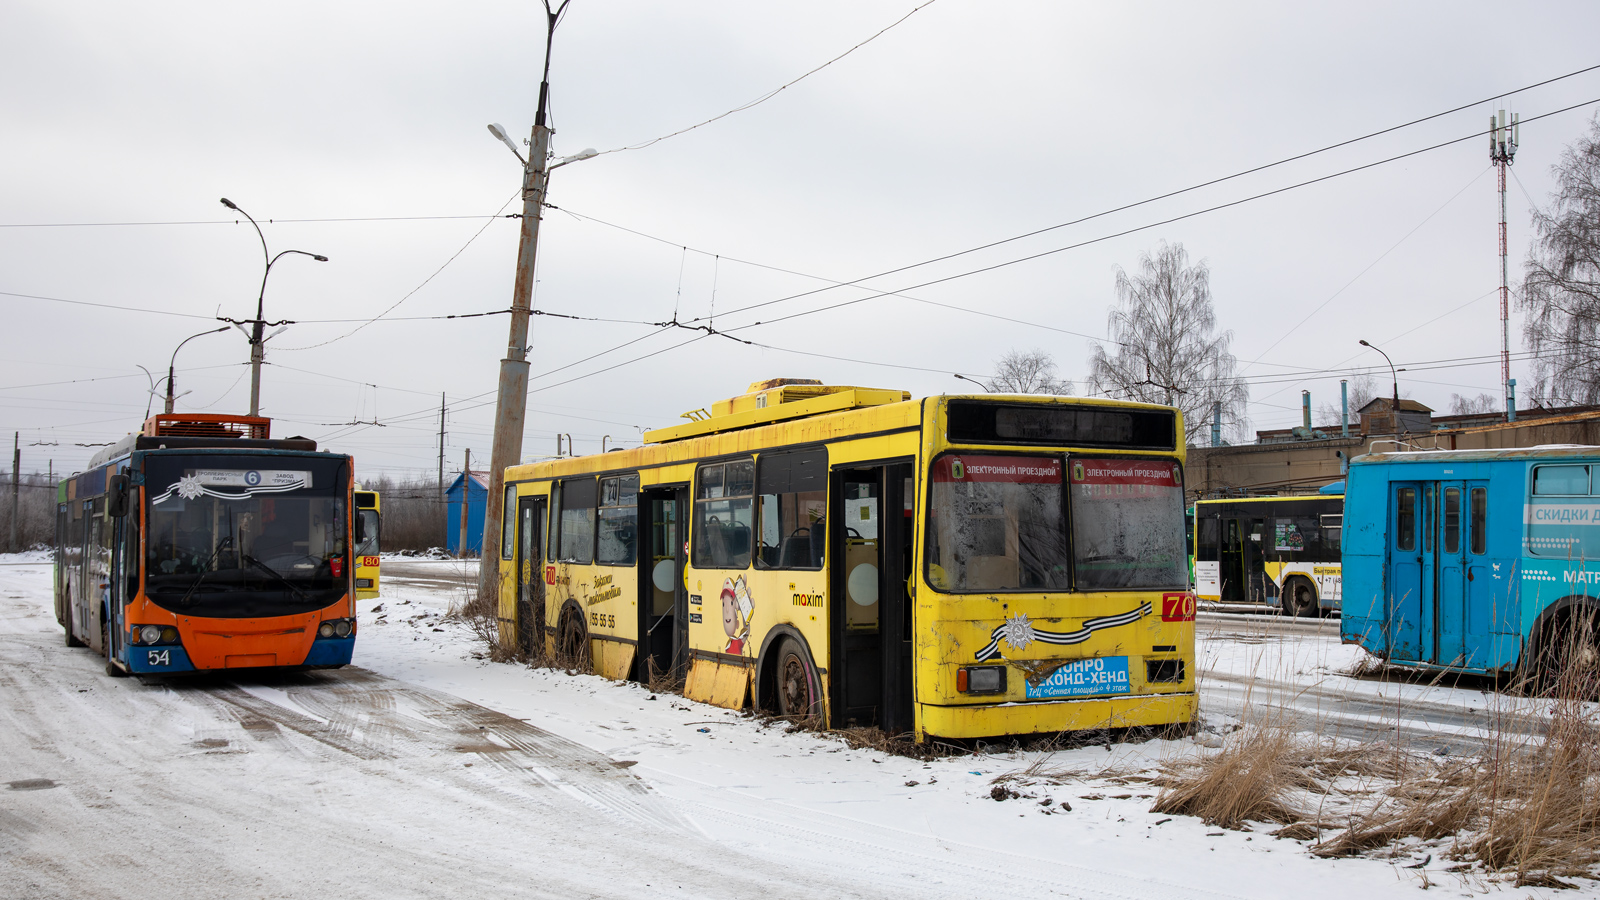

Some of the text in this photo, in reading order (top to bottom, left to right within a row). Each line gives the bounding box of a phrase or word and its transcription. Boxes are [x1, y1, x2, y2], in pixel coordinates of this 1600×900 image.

[247, 472, 258, 484] 6
[967, 465, 1056, 477] ЭЛЕКТРОННЫЙ ПРОЕЗДНОЙ
[1086, 468, 1170, 479] ЭЛЕКТРОННЫЙ ПРОЕЗДНОЙ
[1535, 508, 1589, 523] СКИДКИ
[365, 557, 379, 566] 80
[547, 568, 555, 583] 70
[1563, 570, 1600, 584] МАТР
[792, 590, 824, 608] maxim
[1166, 596, 1195, 618] 70
[148, 650, 169, 665] 54
[1028, 686, 1042, 698] ТРЦ
[1105, 683, 1111, 692] 4
[1111, 684, 1128, 693] этаж
